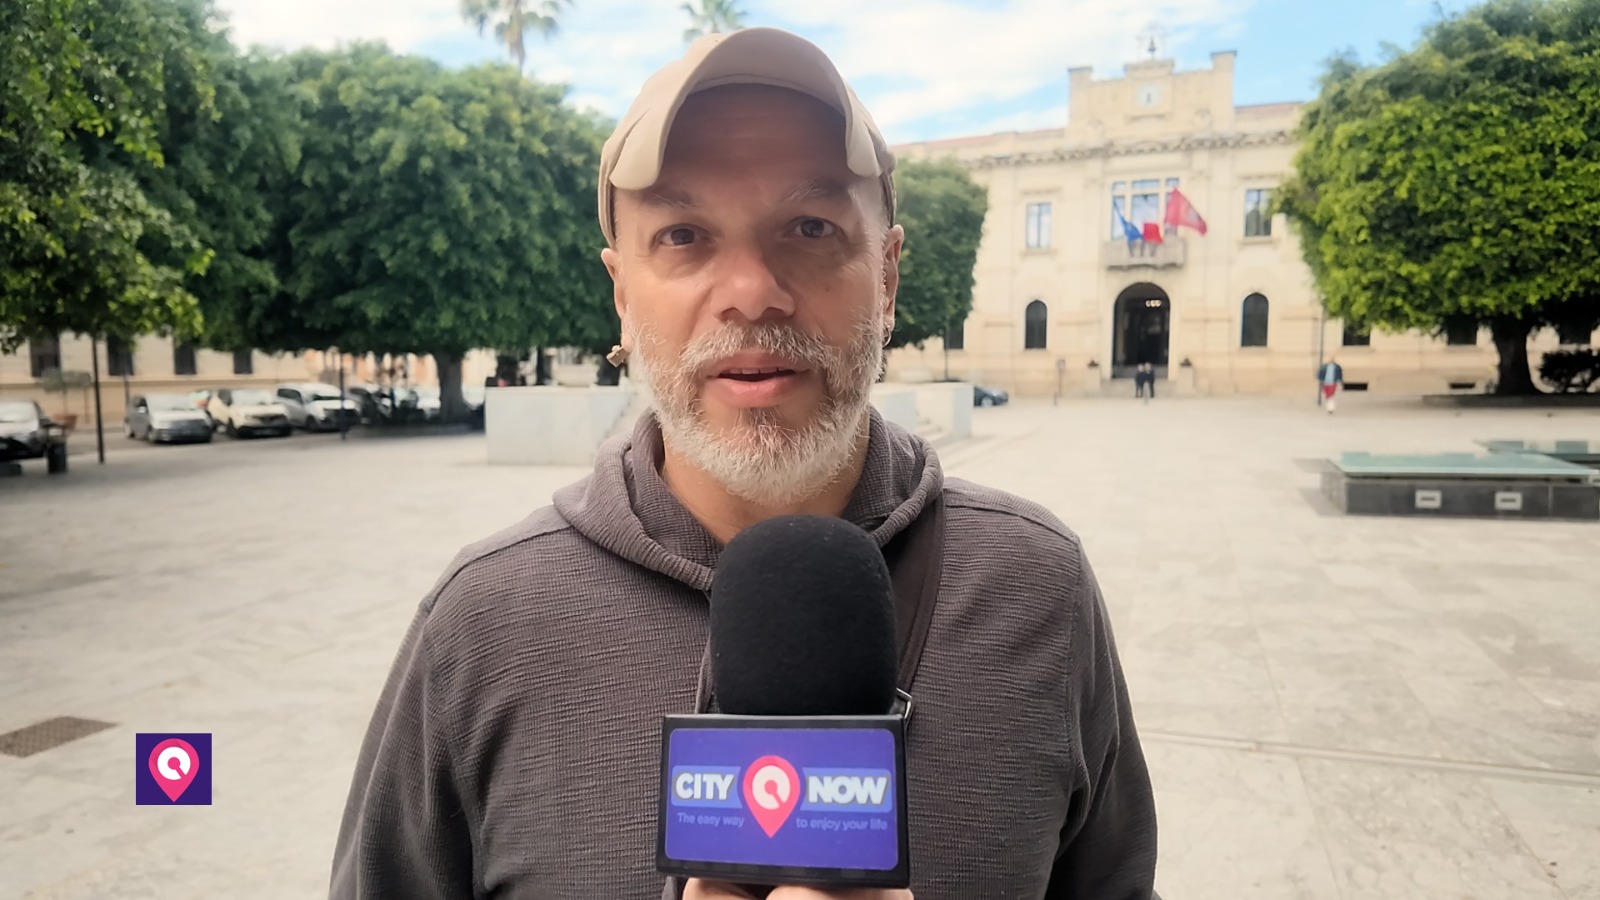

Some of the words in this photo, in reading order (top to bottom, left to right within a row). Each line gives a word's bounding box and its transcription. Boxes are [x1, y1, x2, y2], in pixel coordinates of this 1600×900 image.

[675, 772, 735, 801] CITY
[808, 775, 887, 805] NOW
[677, 812, 696, 824] The
[697, 814, 721, 827] easy
[722, 816, 745, 828] way
[796, 818, 808, 829] to
[810, 817, 840, 832] enjoy
[842, 820, 869, 832] your
[869, 817, 888, 830] life
